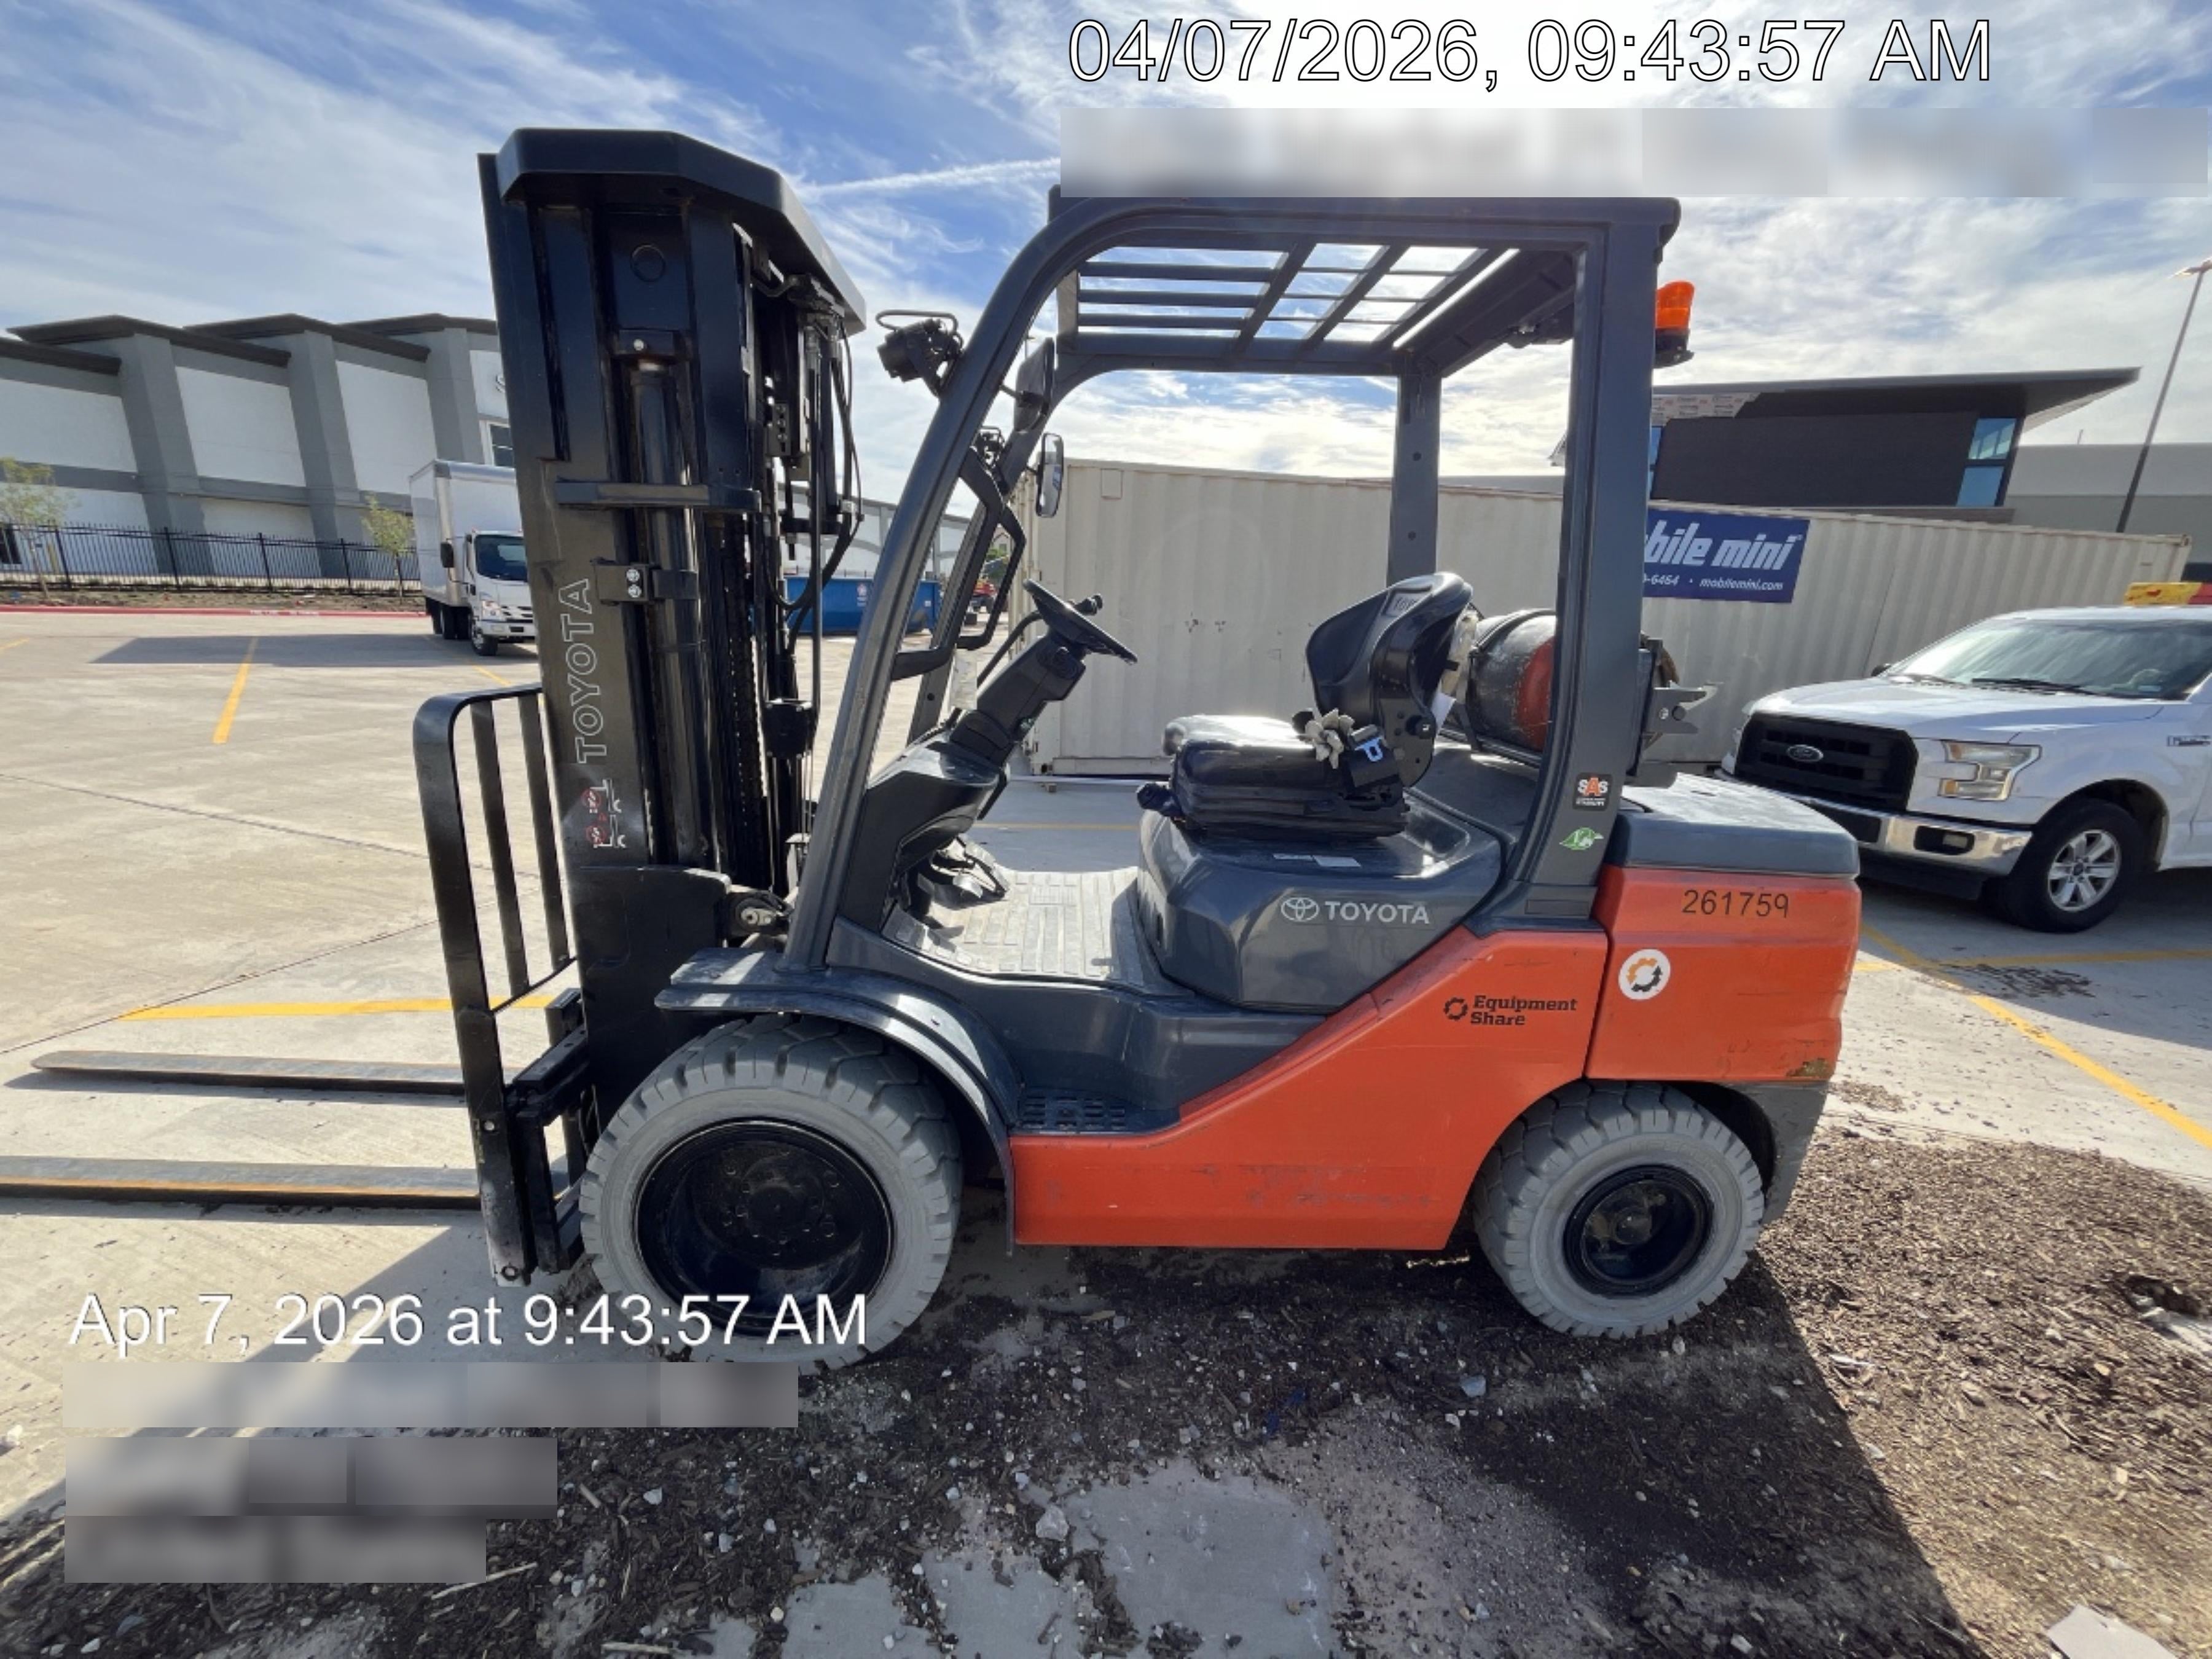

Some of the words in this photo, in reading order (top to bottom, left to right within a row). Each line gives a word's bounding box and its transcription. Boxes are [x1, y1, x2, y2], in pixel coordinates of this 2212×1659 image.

[1644, 520, 1712, 565] bile
[1711, 534, 1796, 570] mini
[1700, 578, 1783, 590] mobilemini.com
[559, 578, 607, 764] TOYOTA
[1577, 777, 1609, 796] SAS
[1325, 901, 1429, 924] TOYOTA
[1682, 889, 1789, 918] 261759
[1473, 994, 1577, 1012] Equipment
[1470, 1011, 1525, 1026] Share
